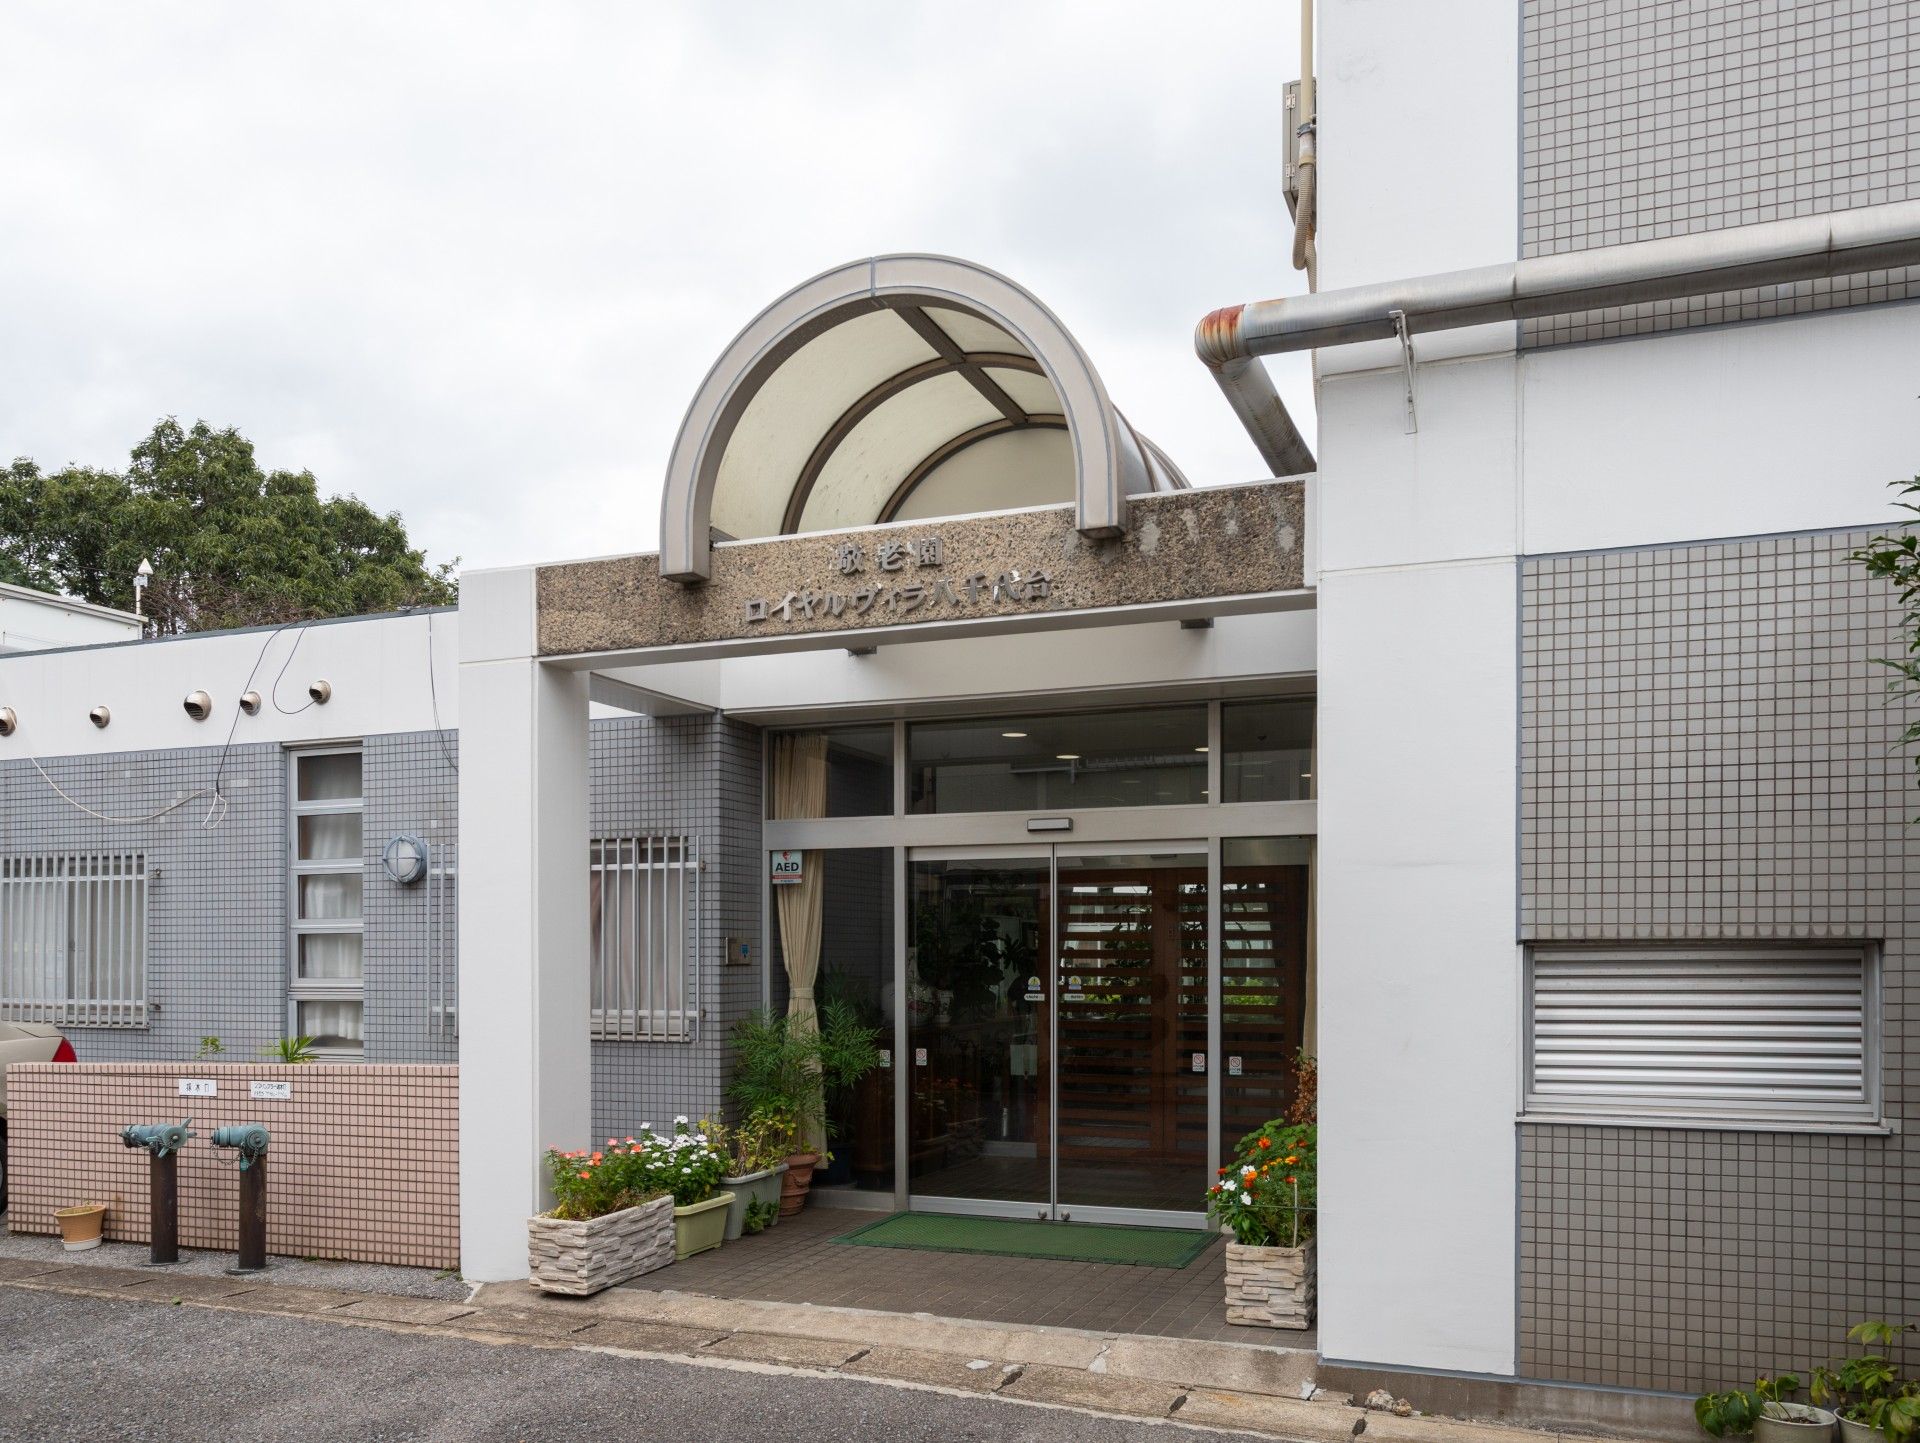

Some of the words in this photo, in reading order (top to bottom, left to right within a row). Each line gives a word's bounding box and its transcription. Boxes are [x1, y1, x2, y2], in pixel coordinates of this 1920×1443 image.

[836, 537, 944, 574] 敬老園
[745, 569, 1051, 622] ロイヤルヴィラ八千代台
[775, 862, 799, 872] AED
